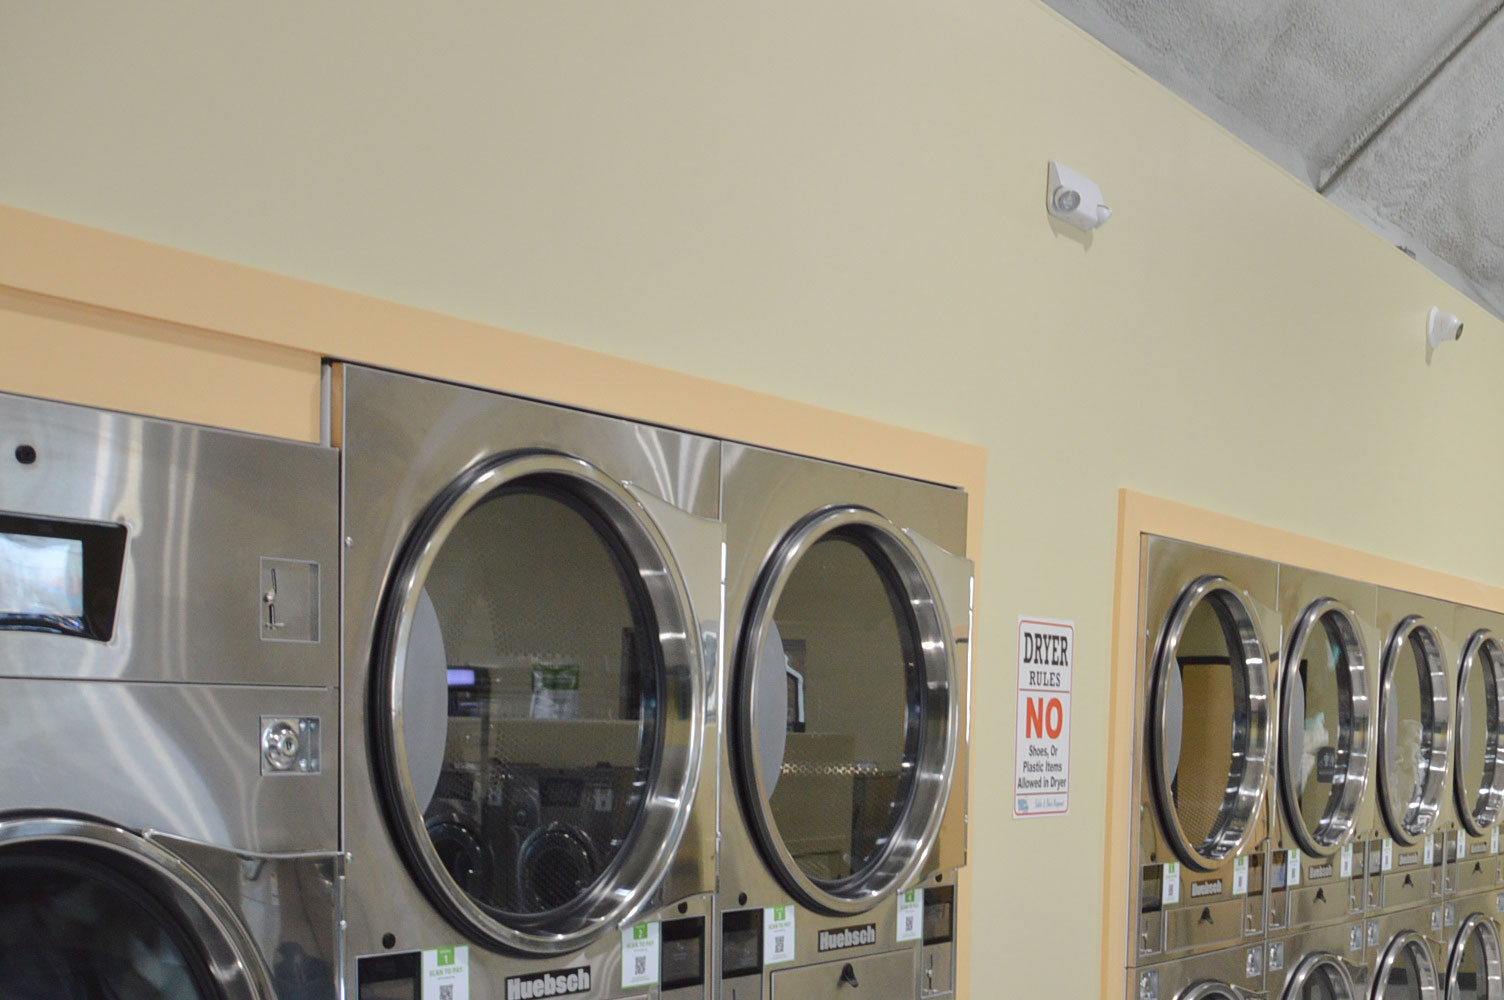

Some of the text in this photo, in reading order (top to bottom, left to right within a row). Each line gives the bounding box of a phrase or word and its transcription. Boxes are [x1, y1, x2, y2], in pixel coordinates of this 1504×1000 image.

[1023, 632, 1068, 666] DRYER
[1029, 670, 1061, 687] RULES
[1025, 697, 1063, 739] NO
[1028, 744, 1058, 758] Shoes, Or
[1023, 760, 1062, 773] Plastic Items
[1017, 776, 1067, 791] Allowed in Dryer
[820, 926, 875, 950] Huebsch
